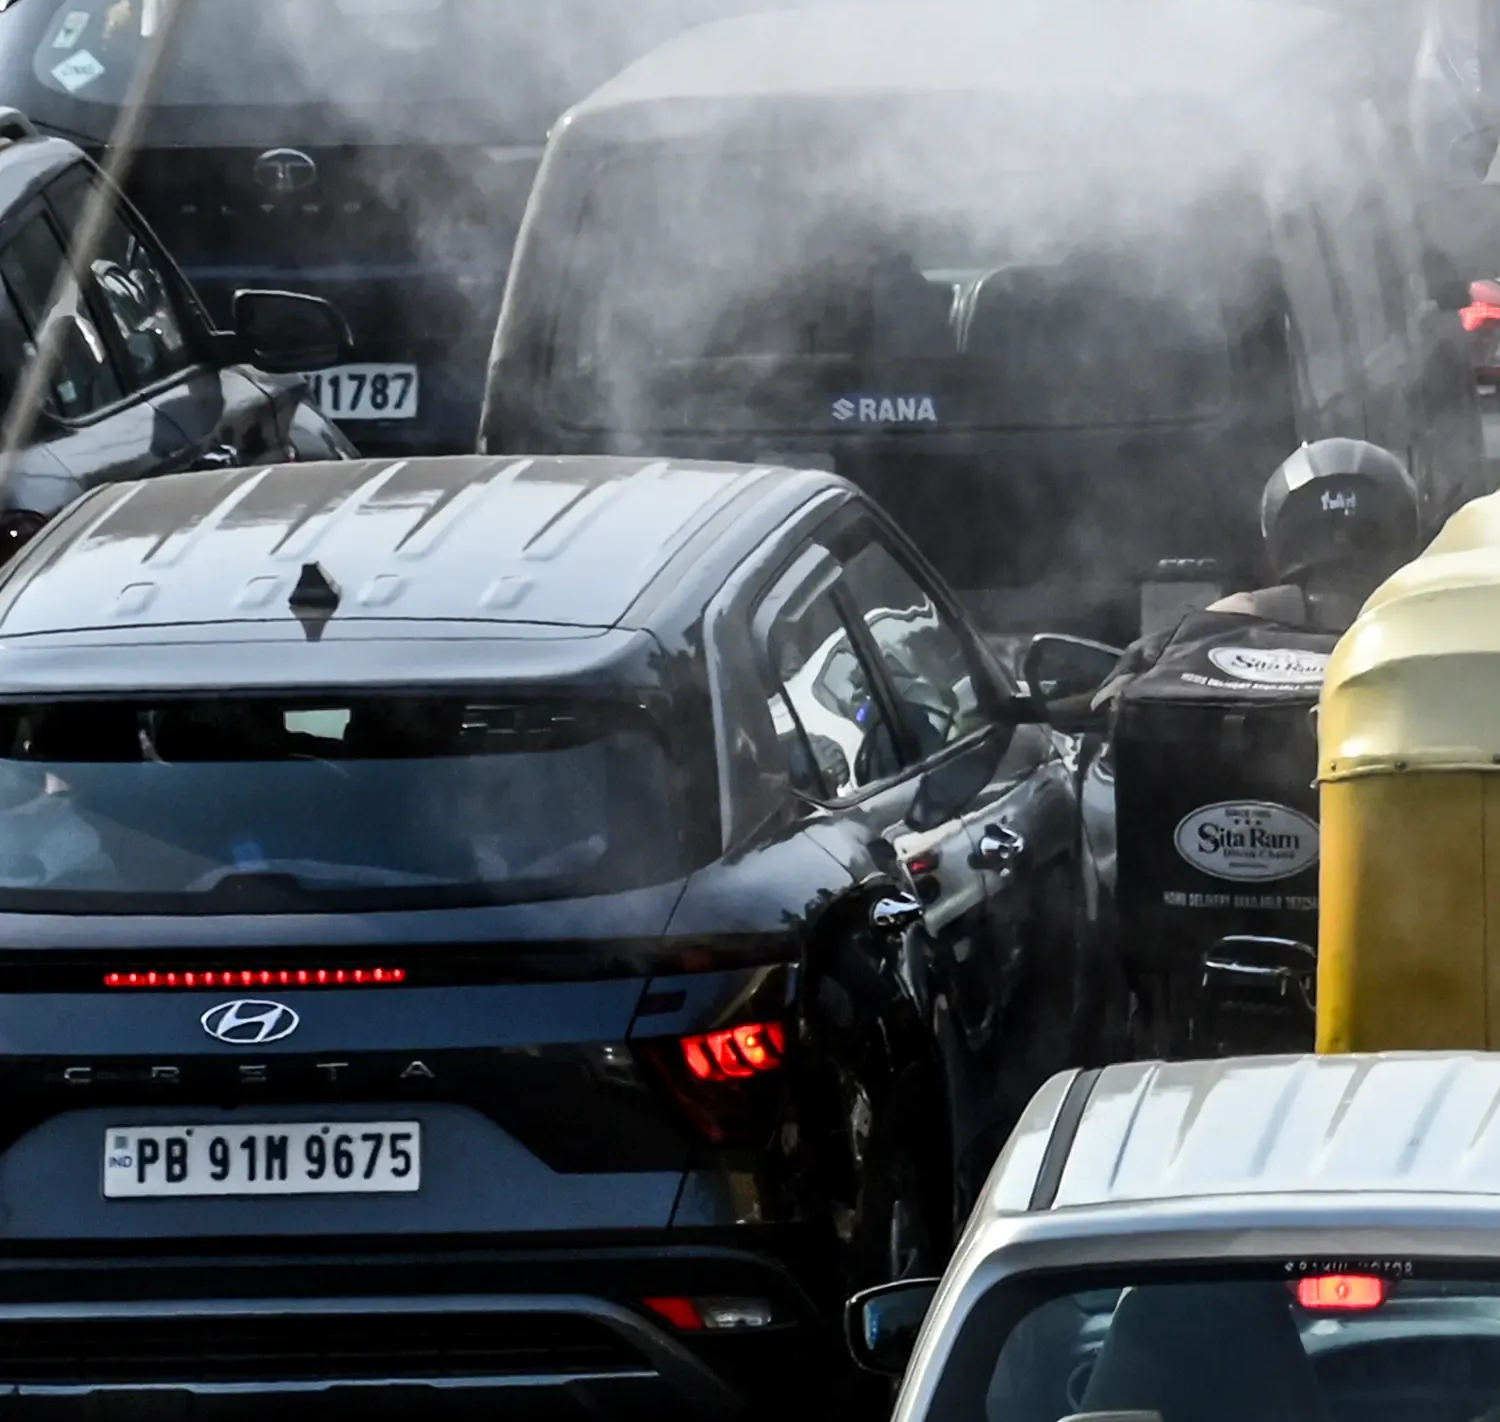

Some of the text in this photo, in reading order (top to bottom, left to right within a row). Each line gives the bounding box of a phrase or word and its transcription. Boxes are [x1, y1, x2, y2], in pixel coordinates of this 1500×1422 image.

[860, 397, 938, 422] RANA
[1198, 822, 1300, 854] Sita Ram
[63, 1060, 435, 1083] CRETA
[109, 1132, 412, 1184] IND PB 91M 9675
